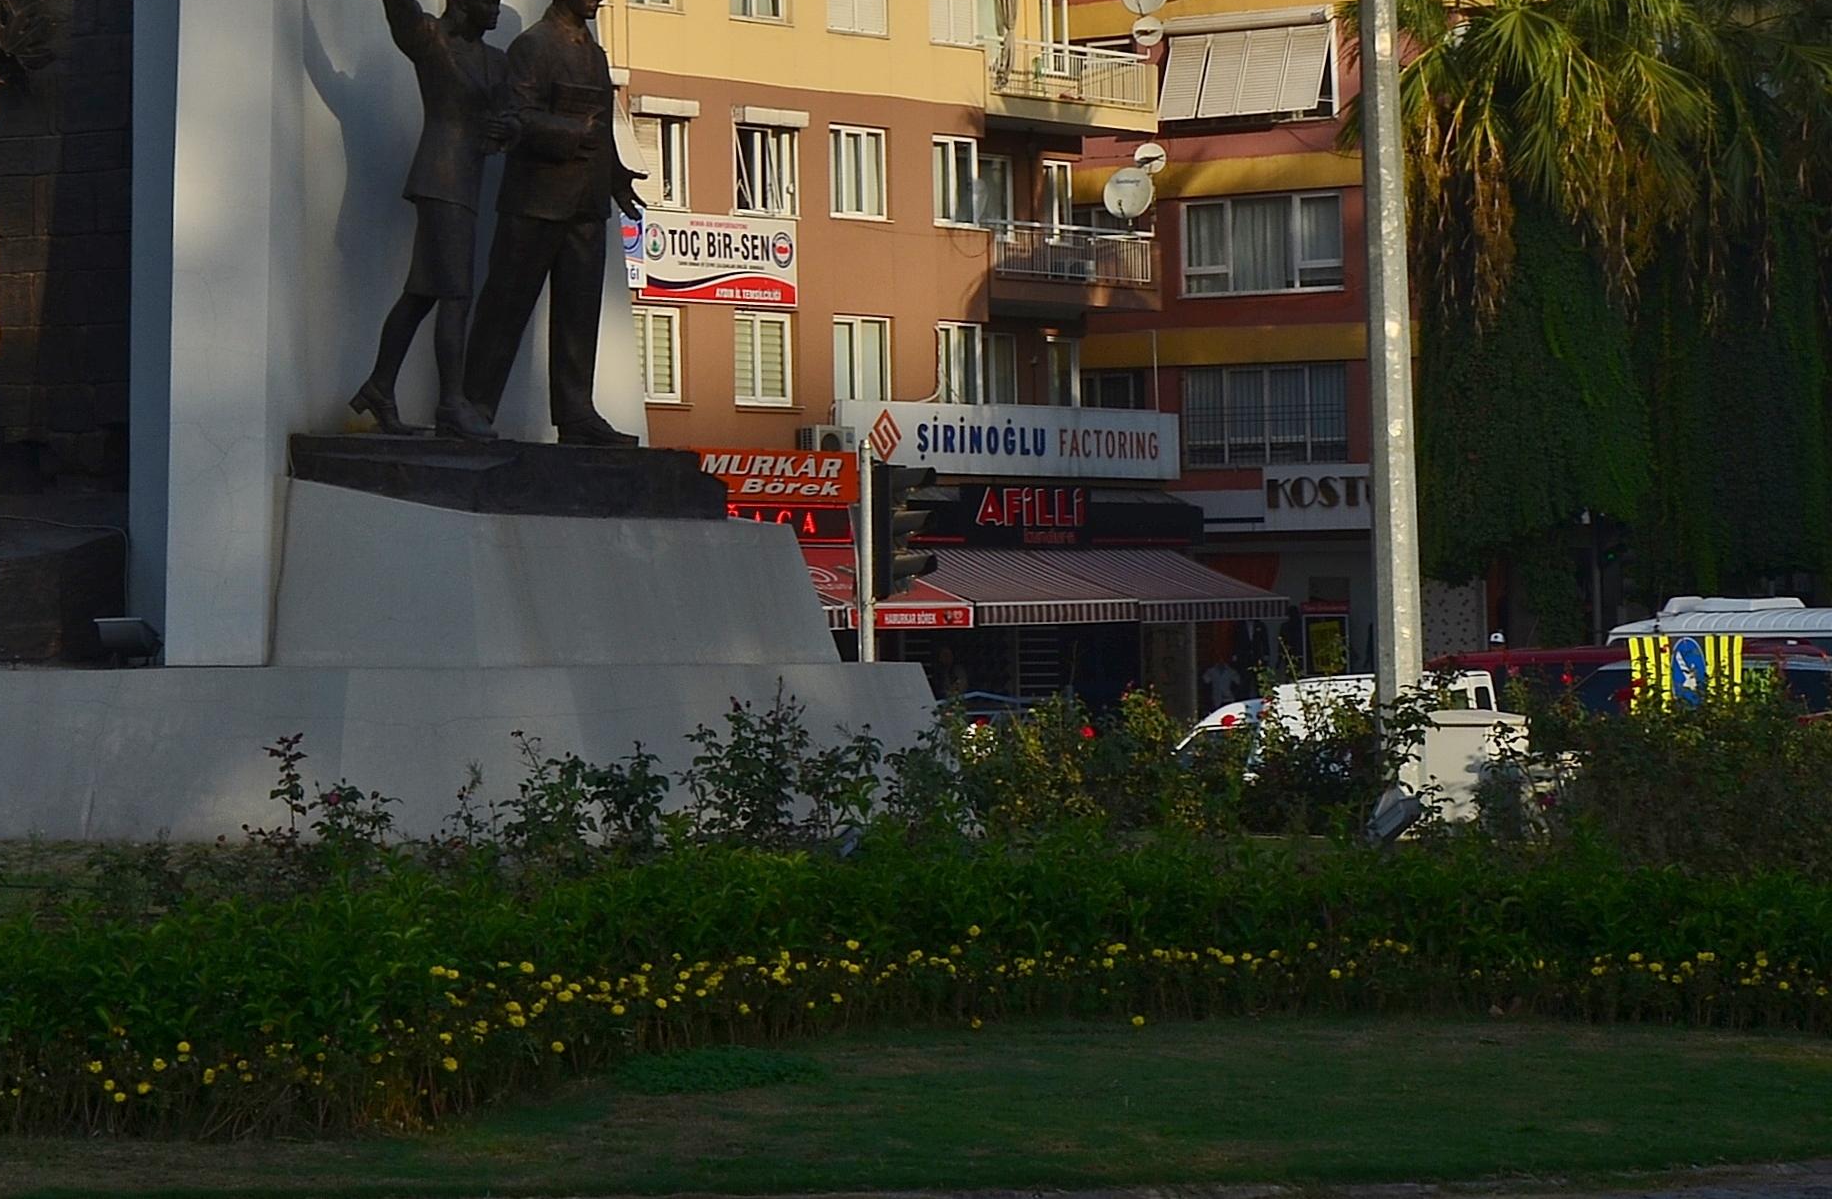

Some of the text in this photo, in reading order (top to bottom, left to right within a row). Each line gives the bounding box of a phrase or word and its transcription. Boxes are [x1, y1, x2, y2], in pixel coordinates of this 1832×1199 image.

[668, 229, 700, 261] TOÇ
[1058, 428, 1160, 461] FACTORING
[740, 478, 842, 497] Börek
[1266, 475, 1371, 510] KOST
